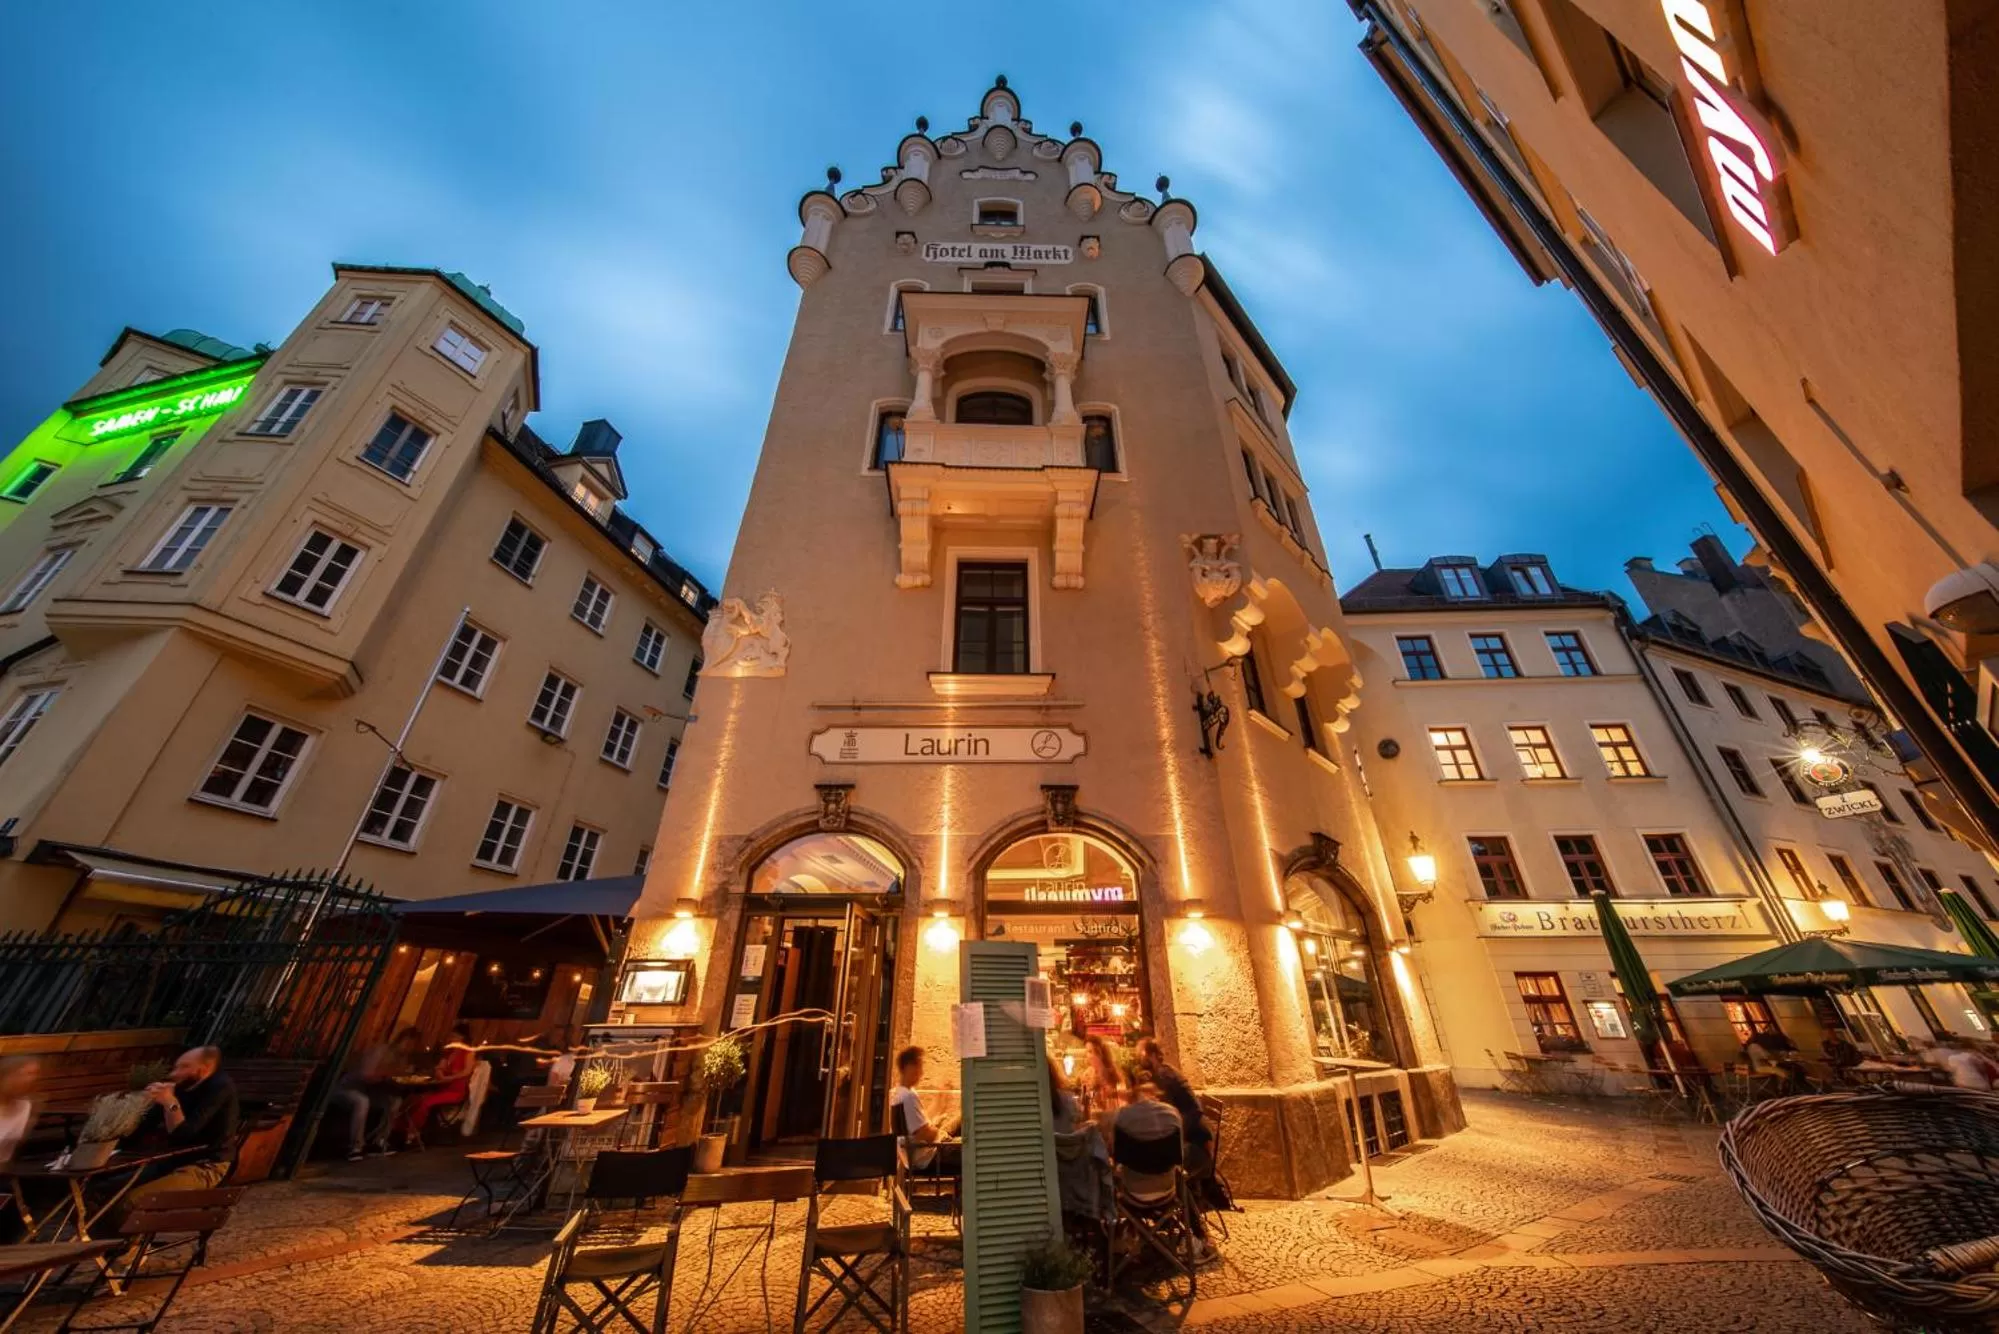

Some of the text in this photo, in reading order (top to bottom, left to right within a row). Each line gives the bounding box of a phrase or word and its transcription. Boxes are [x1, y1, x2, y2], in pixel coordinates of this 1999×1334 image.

[924, 243, 1071, 261] Hotel am Markt
[904, 732, 990, 757] Laurin
[1536, 908, 1753, 931] Braturstherzl
